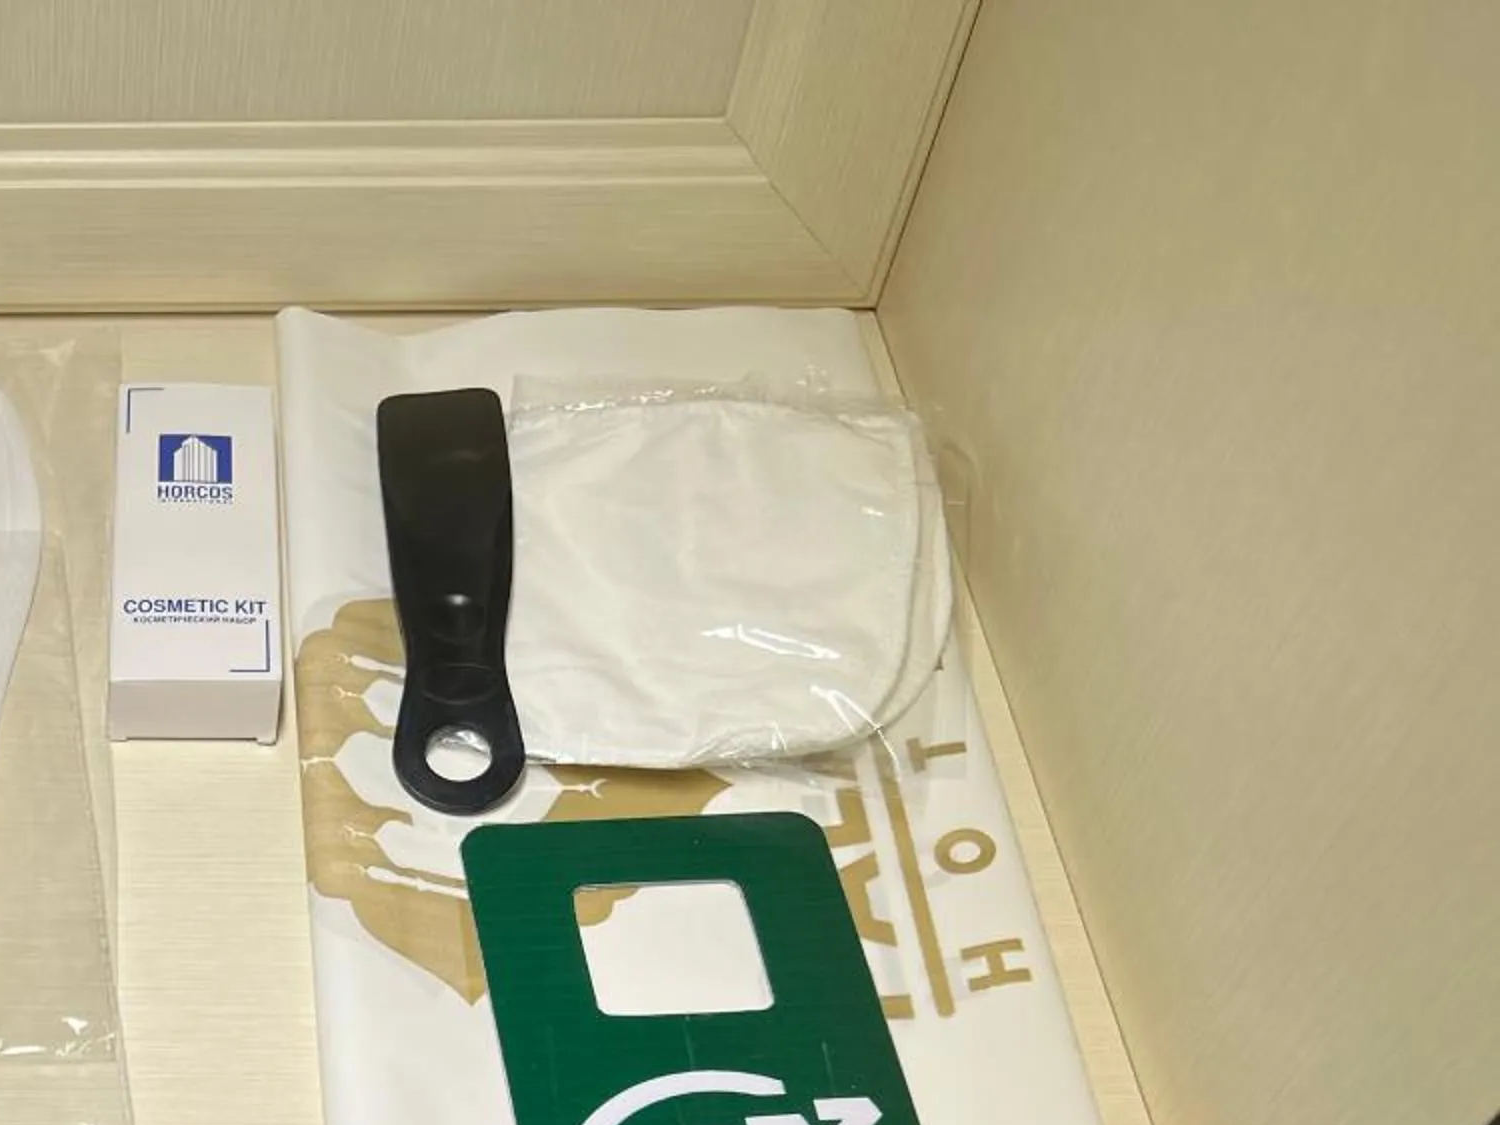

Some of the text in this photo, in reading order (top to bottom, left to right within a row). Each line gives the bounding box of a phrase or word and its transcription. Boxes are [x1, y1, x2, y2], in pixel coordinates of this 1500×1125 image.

[157, 485, 234, 499] HORCOS
[123, 599, 267, 614] COSMETIC KIT
[906, 665, 1033, 992] HOT
